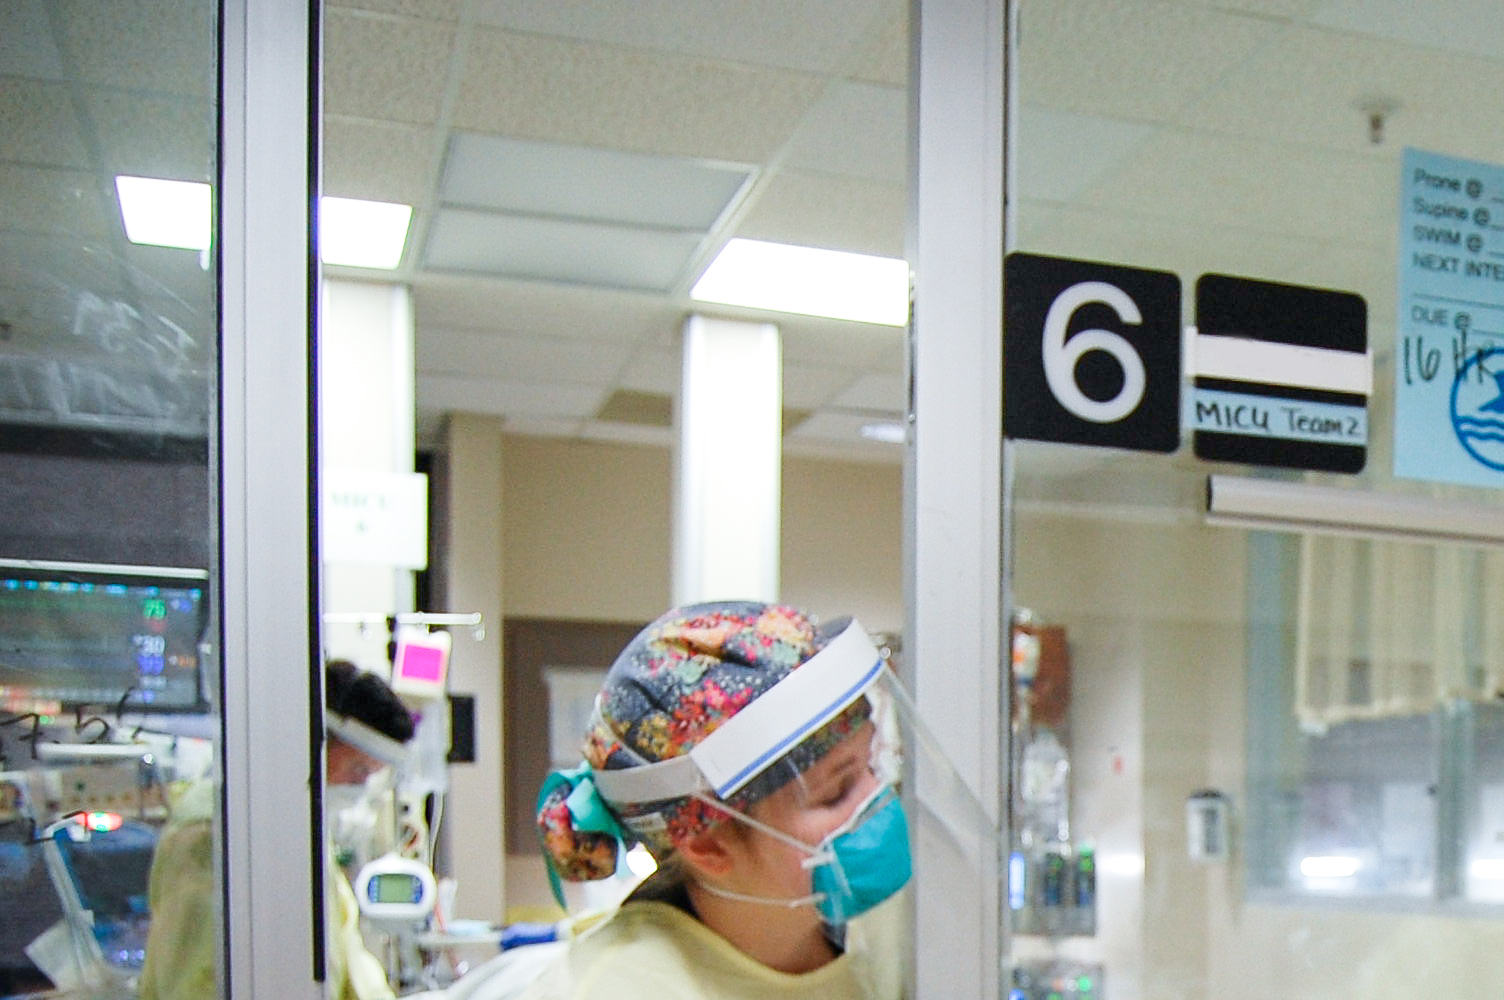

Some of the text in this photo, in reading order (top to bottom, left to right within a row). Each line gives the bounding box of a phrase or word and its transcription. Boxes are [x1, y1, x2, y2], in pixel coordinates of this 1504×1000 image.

[1414, 168, 1462, 192] Prone
[1413, 197, 1469, 221] Supine
[1413, 224, 1461, 245] SWIM
[1413, 252, 1460, 273] NEXT
[1411, 304, 1448, 326] DUE
[1042, 281, 1146, 424] 6
[1404, 335, 1441, 385] 16
[1195, 401, 1269, 431] MICU
